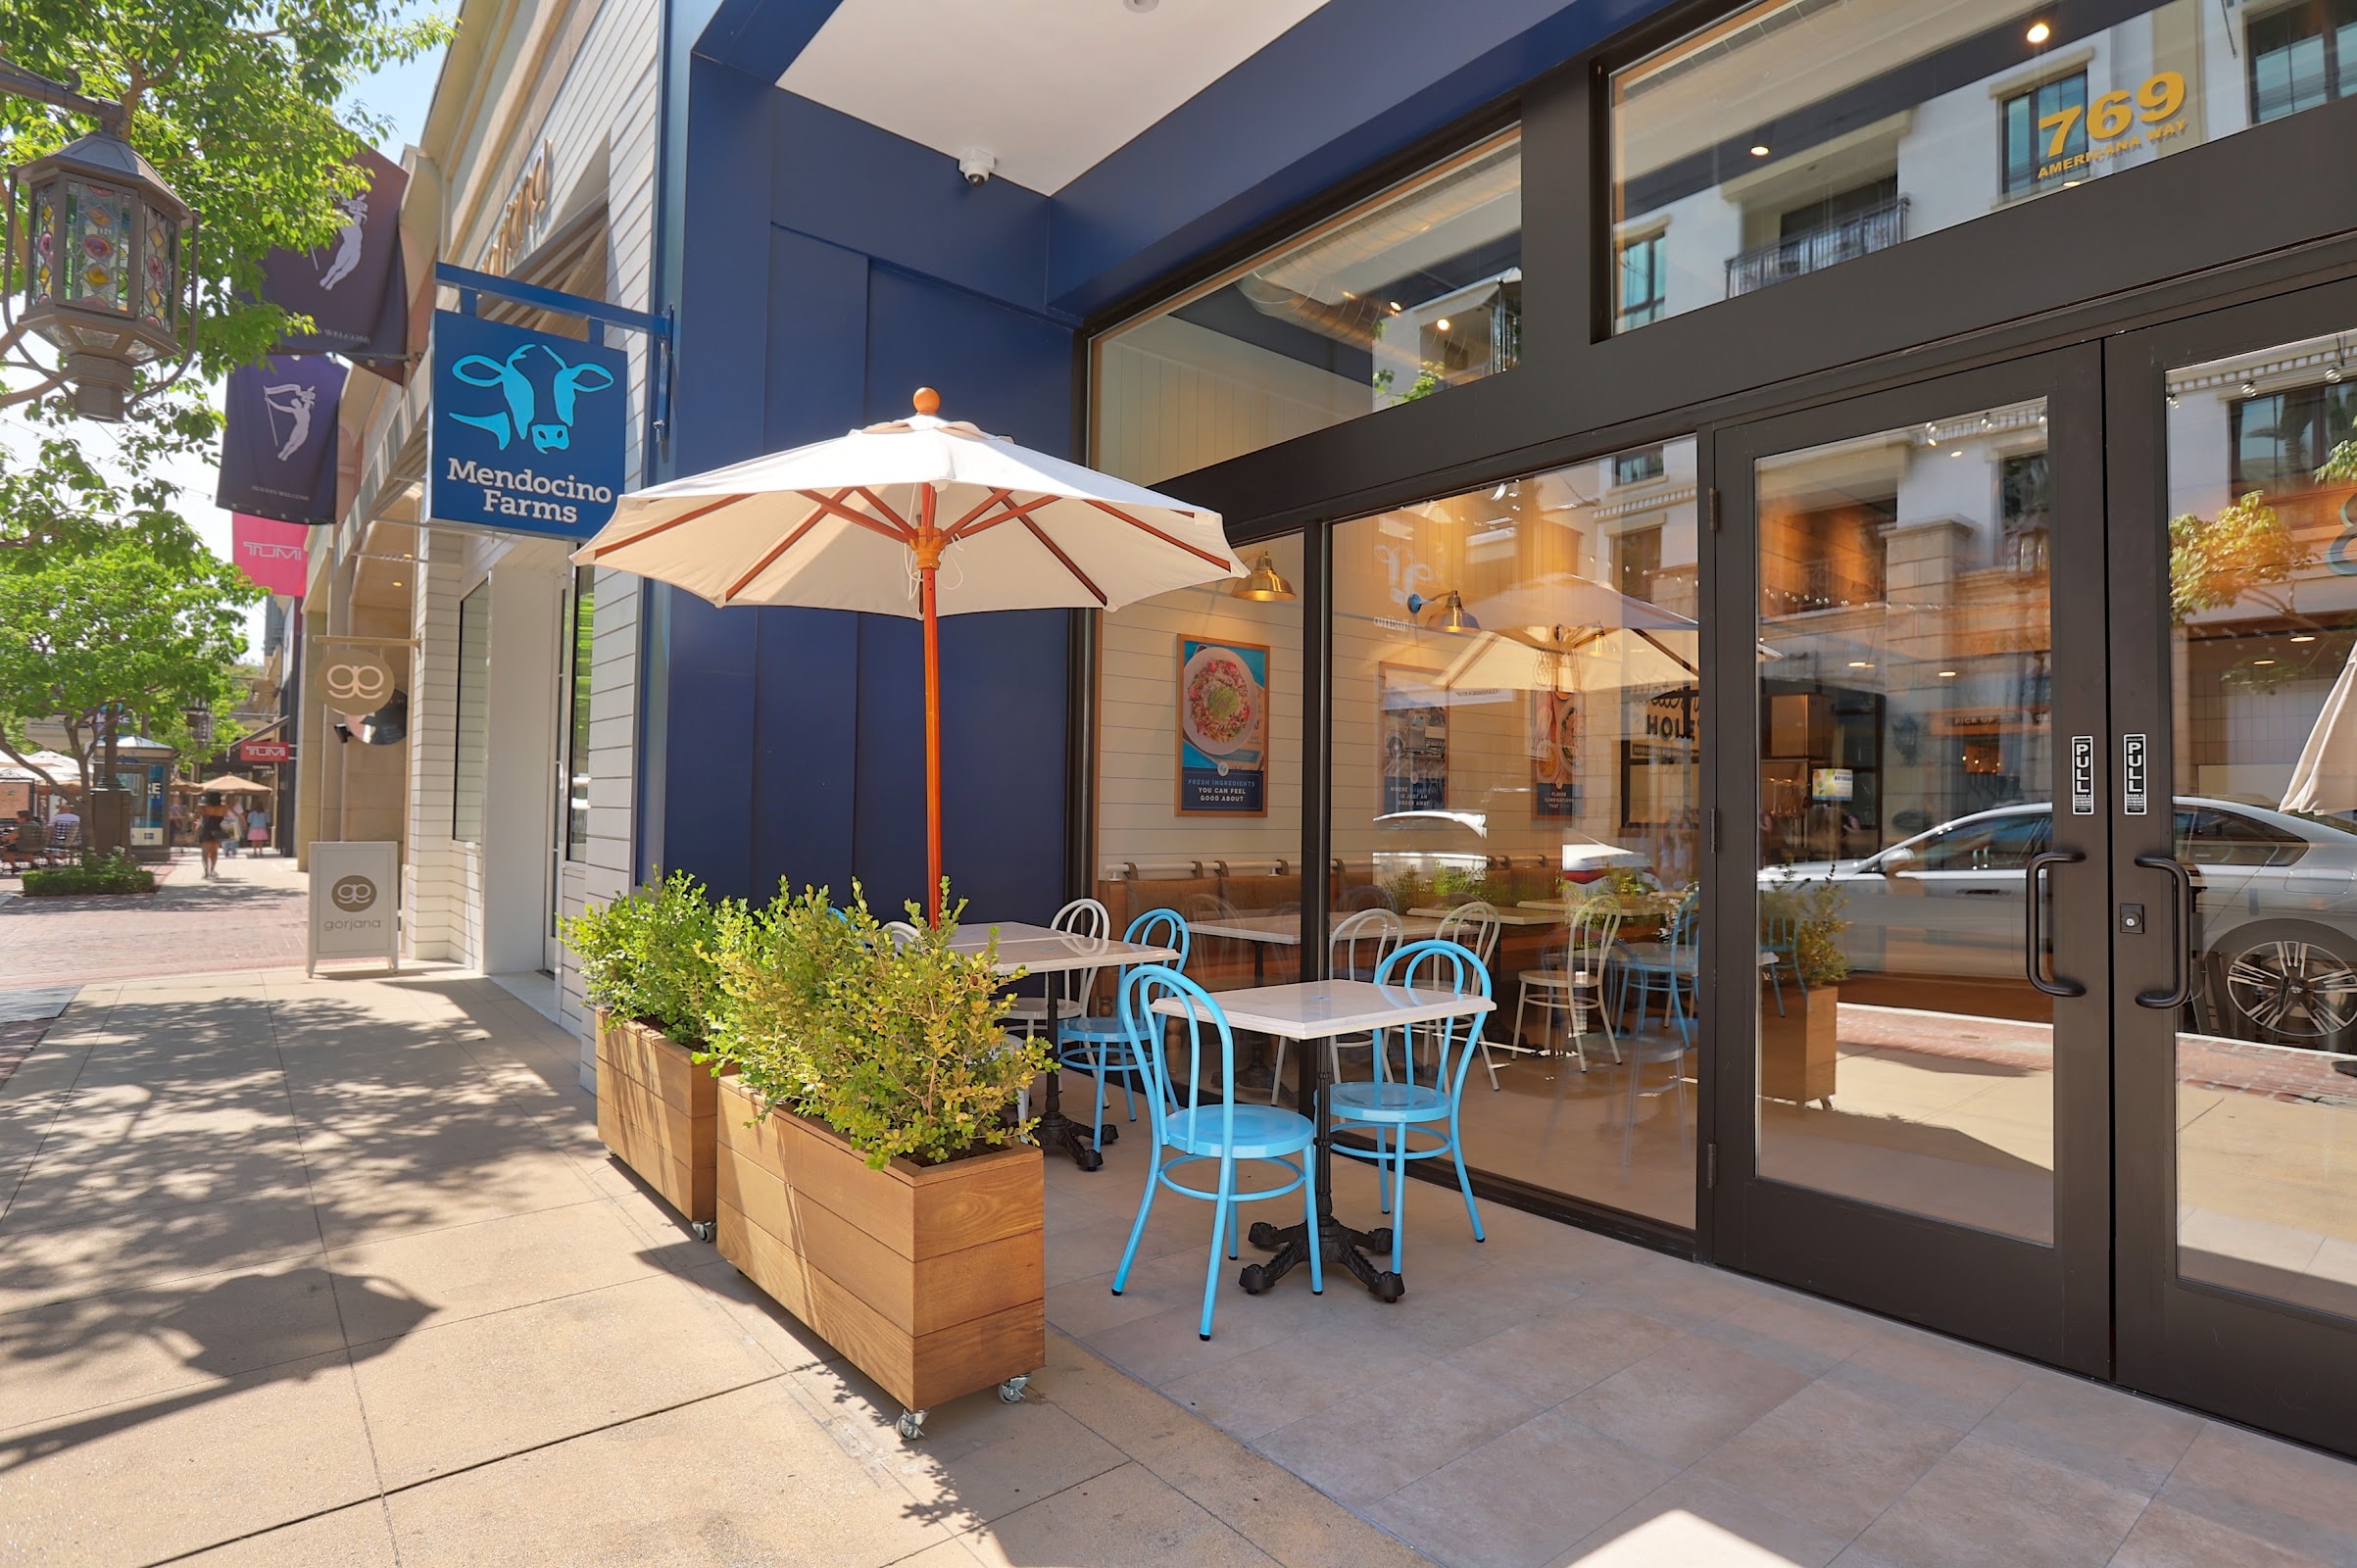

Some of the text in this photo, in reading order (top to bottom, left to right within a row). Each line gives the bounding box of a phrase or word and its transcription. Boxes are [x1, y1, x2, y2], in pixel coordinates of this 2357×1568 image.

[2038, 71, 2185, 158] 769
[2038, 118, 2186, 179] AMERICANA WAY
[447, 458, 613, 504] Mendocino
[483, 489, 577, 523] Farms
[243, 541, 302, 561] TUMI
[245, 745, 286, 757] TUMI
[2076, 744, 2089, 793] PULL
[2128, 742, 2142, 792] PULL
[323, 919, 381, 932] gorjana
